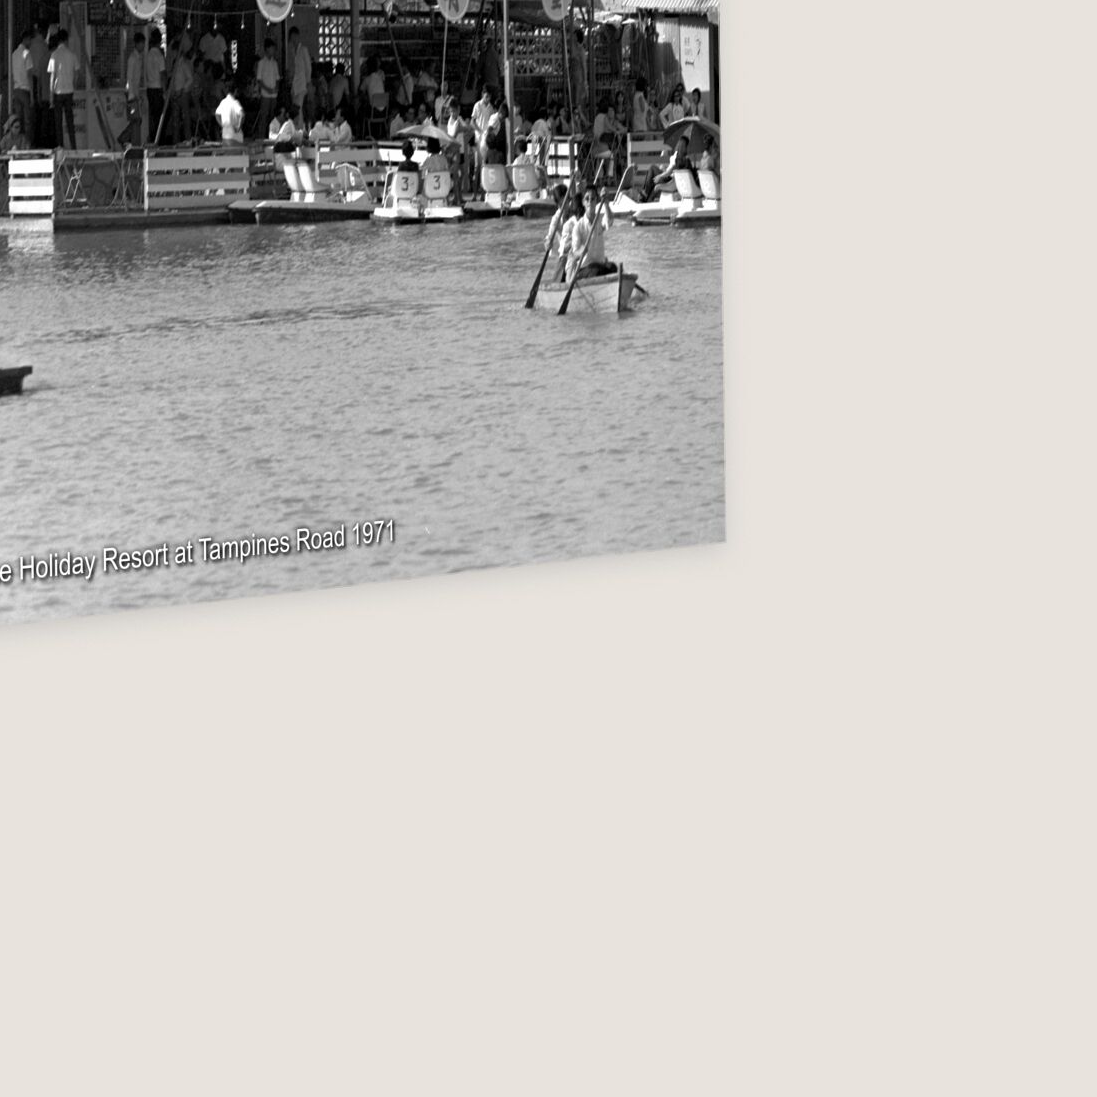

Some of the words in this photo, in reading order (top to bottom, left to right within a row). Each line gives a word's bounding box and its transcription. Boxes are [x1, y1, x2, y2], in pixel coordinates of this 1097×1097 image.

[432, 174, 441, 191] 3
[519, 168, 528, 183] 5
[401, 176, 409, 192] 3
